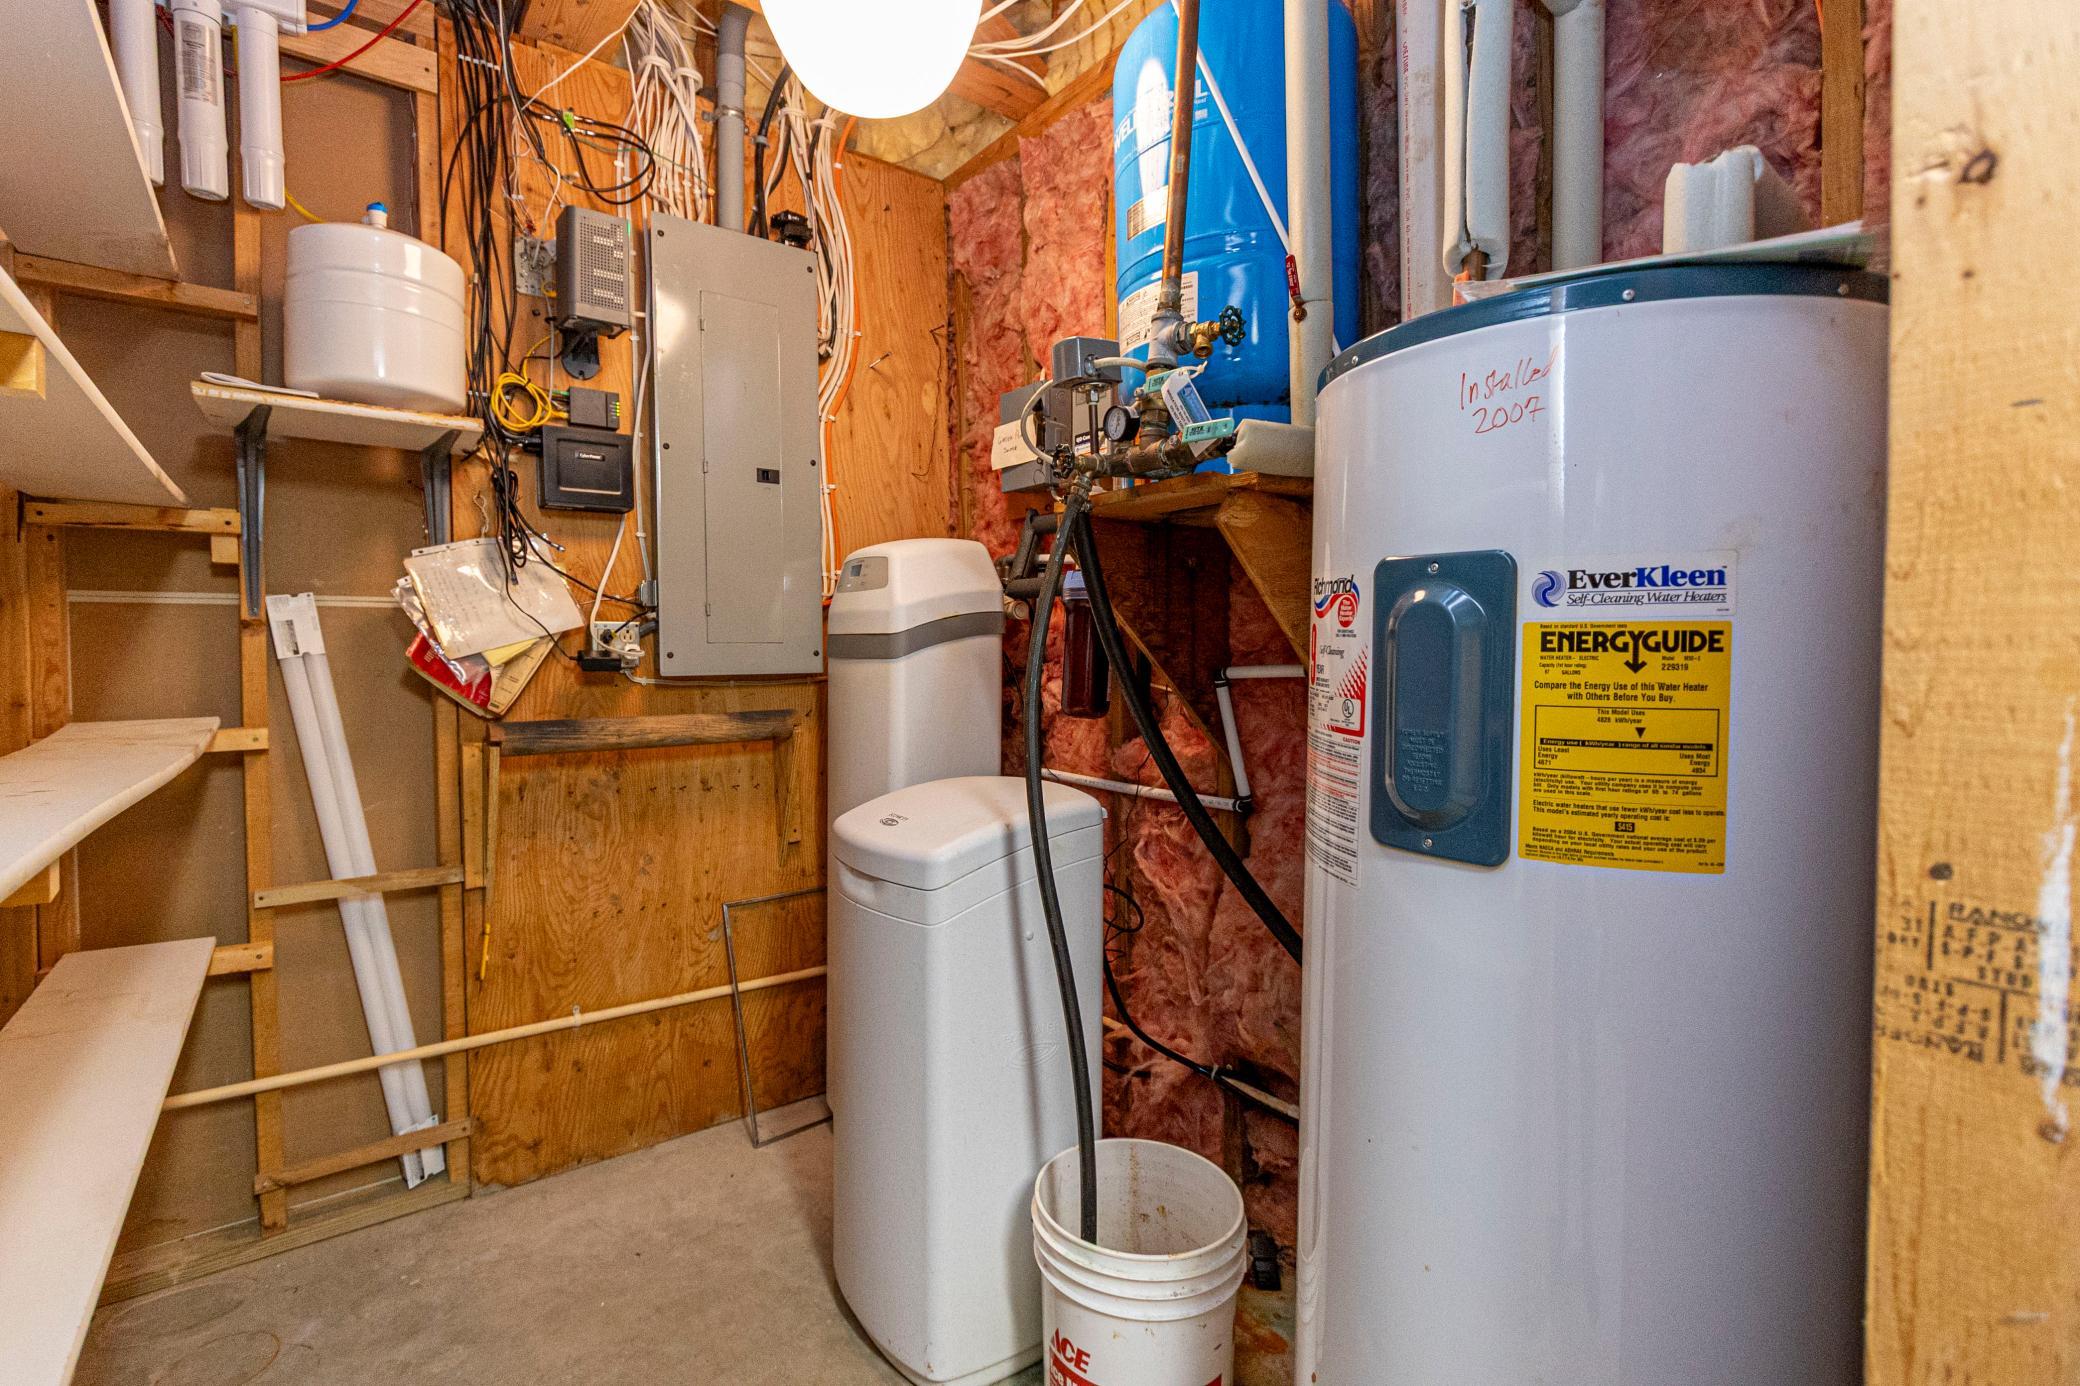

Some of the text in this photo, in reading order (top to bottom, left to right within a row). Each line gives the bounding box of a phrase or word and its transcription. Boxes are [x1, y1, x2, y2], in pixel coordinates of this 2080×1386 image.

[1460, 345, 1559, 410] Installed
[1472, 396, 1546, 434] 2007
[1567, 565, 1727, 589] EverKleen
[1566, 591, 1727, 607] Self-Cleaning Water Heaters
[1540, 630, 1724, 652] ENERGYGUIDE
[1661, 663, 1689, 671] 229319
[1534, 680, 1709, 692] Compare the Energy Use of this Water Heater
[1567, 692, 1583, 700] with
[1585, 692, 1611, 701] Others
[1613, 692, 1638, 701] Before
[1641, 693, 1656, 702] You
[1343, 737, 1361, 745] CAUTION
[1689, 759, 1711, 767] Energy
[1572, 802, 1595, 810] heaters
[1640, 806, 1668, 814] kWh/year
[1546, 807, 1570, 815] model's
[1571, 809, 1599, 817] estimated
[1600, 812, 1619, 820] yearly
[1620, 813, 1649, 822] operating
[1617, 822, 1633, 831] $415
[1532, 836, 1560, 845] depending
[1591, 831, 1625, 839] Government
[1642, 840, 1669, 848] operating
[1050, 1328, 1091, 1375] ACE
